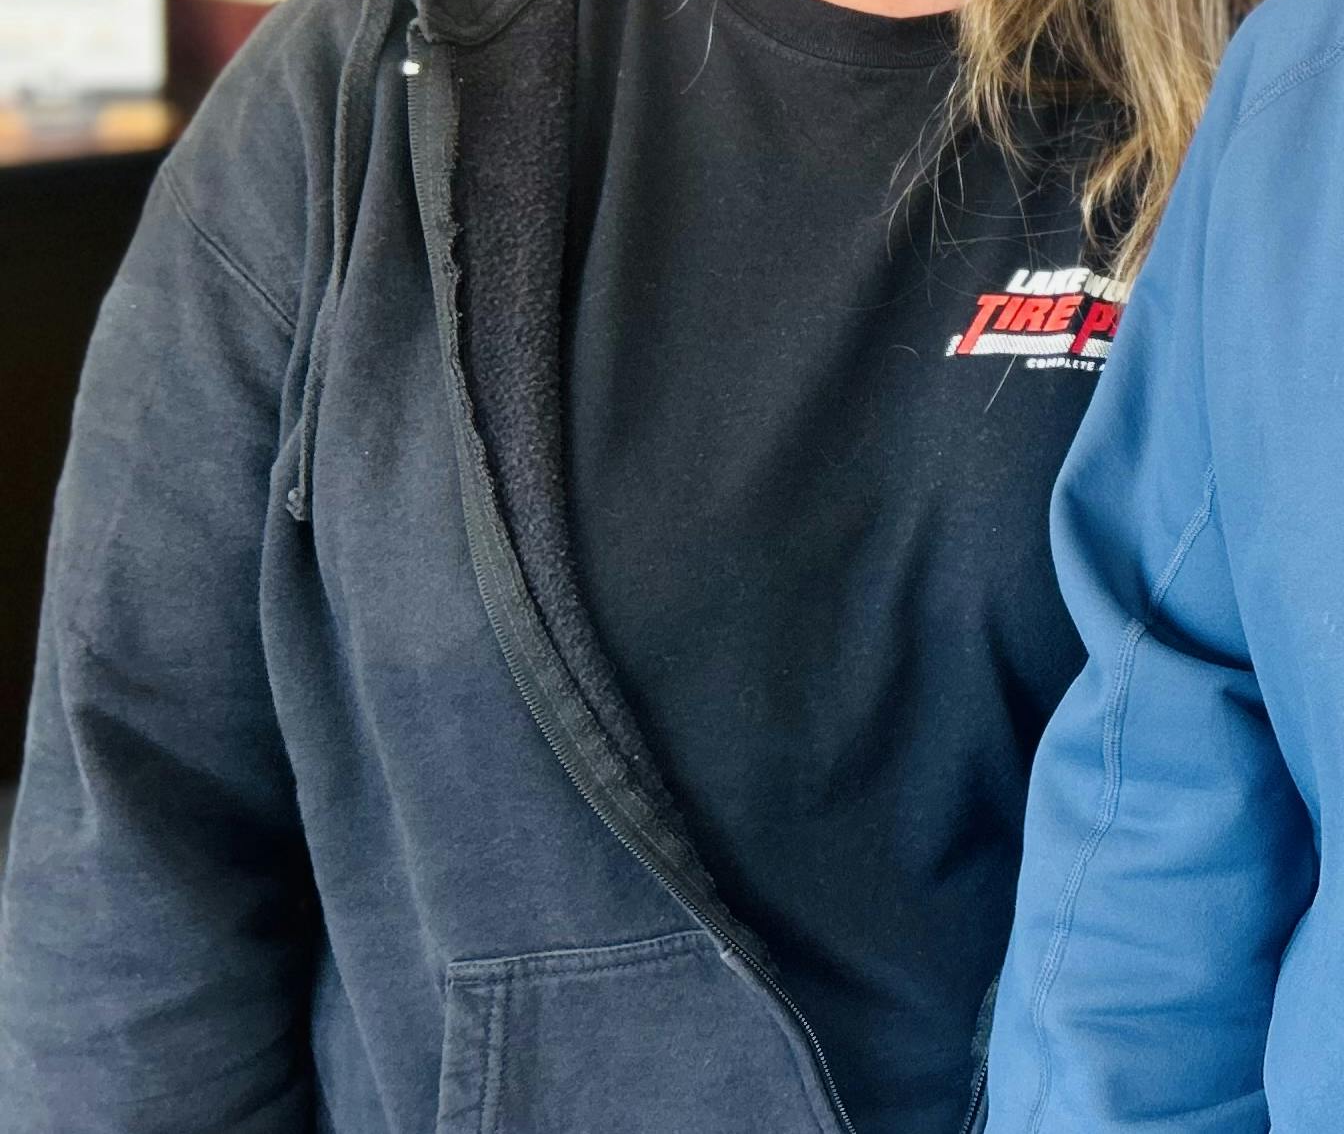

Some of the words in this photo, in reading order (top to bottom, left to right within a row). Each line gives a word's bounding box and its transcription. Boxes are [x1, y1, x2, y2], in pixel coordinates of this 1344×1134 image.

[1005, 267, 1129, 304] LAKEW
[955, 294, 1085, 356] TIRE
[1026, 357, 1096, 372] COMPLETE
